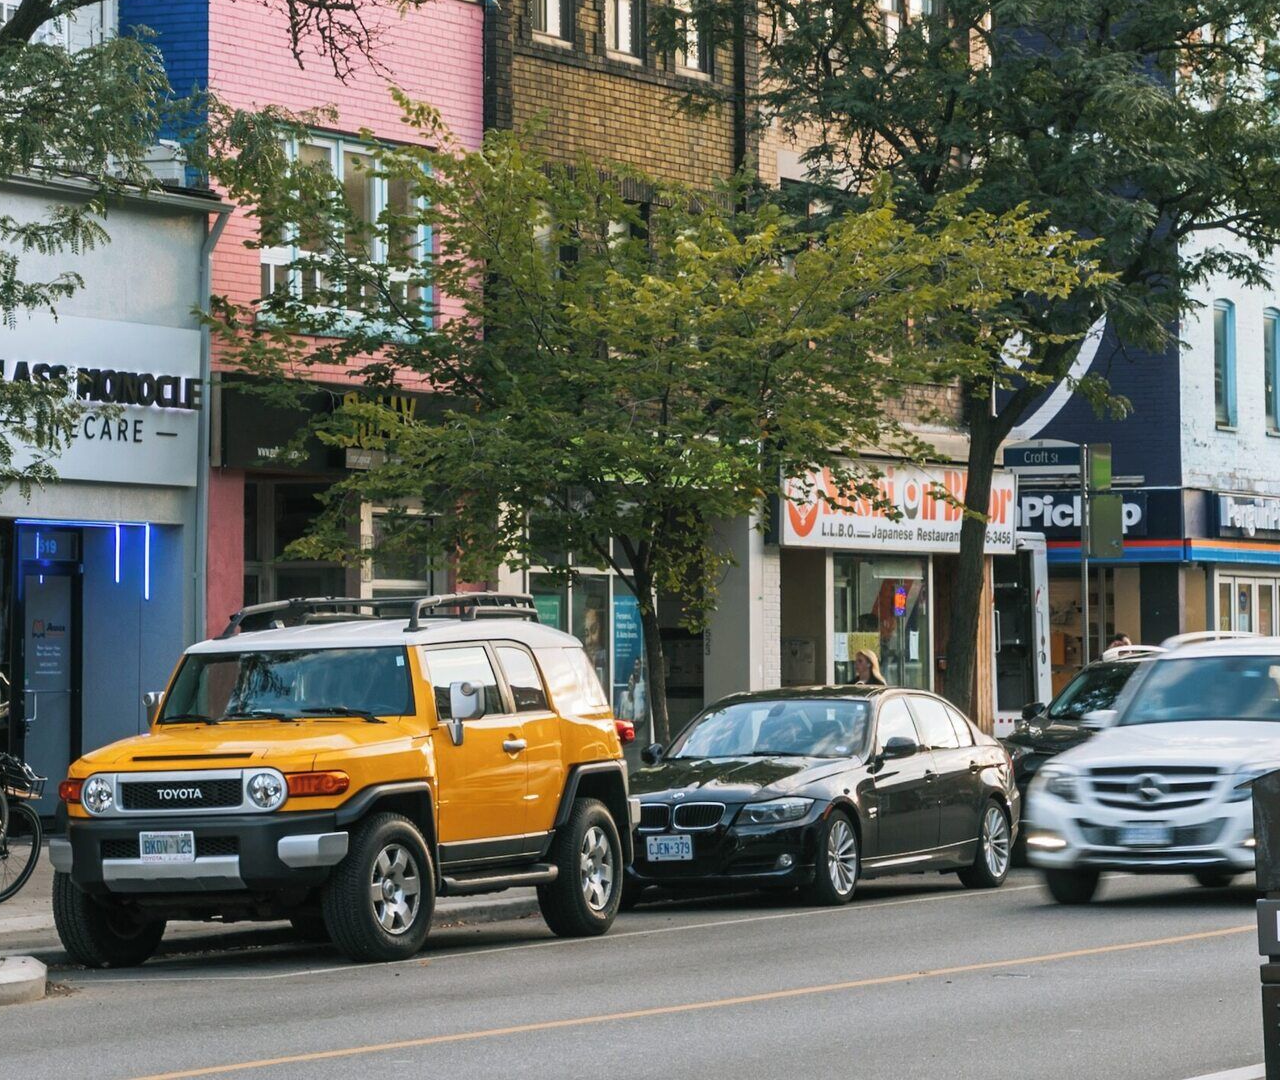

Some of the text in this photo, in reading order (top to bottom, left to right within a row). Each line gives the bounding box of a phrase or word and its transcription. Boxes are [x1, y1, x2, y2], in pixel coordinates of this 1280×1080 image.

[77, 368, 203, 409] MONOCLE
[1023, 451, 1059, 464] Croft St
[872, 524, 914, 542] Japanese
[917, 528, 961, 542] Restauran
[157, 788, 203, 800] TOYOTA
[649, 841, 690, 855] CJEN 379
